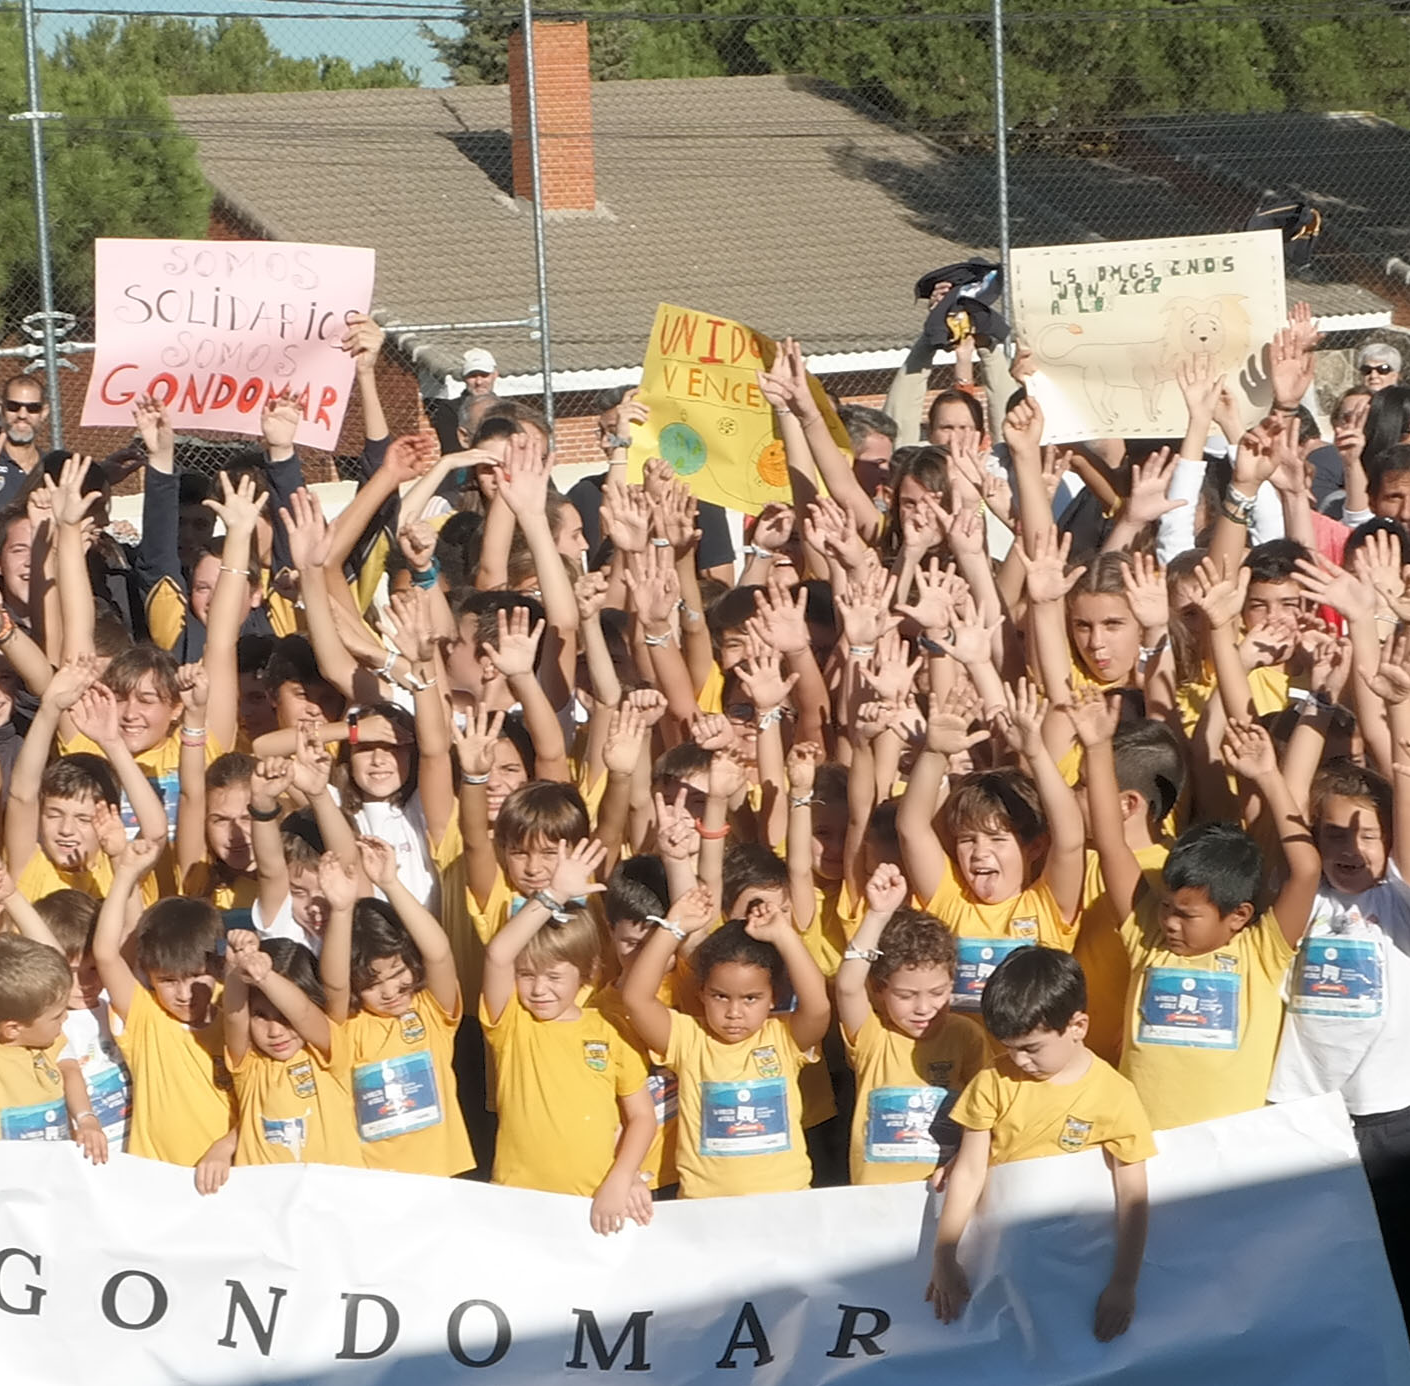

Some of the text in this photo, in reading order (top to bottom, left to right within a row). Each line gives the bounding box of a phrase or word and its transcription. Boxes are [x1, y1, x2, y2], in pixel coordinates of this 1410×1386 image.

[163, 246, 319, 290] SOMOS
[161, 331, 301, 377] SOMOS
[100, 364, 338, 431] GONDOMAR
[663, 364, 767, 409] VENCE
